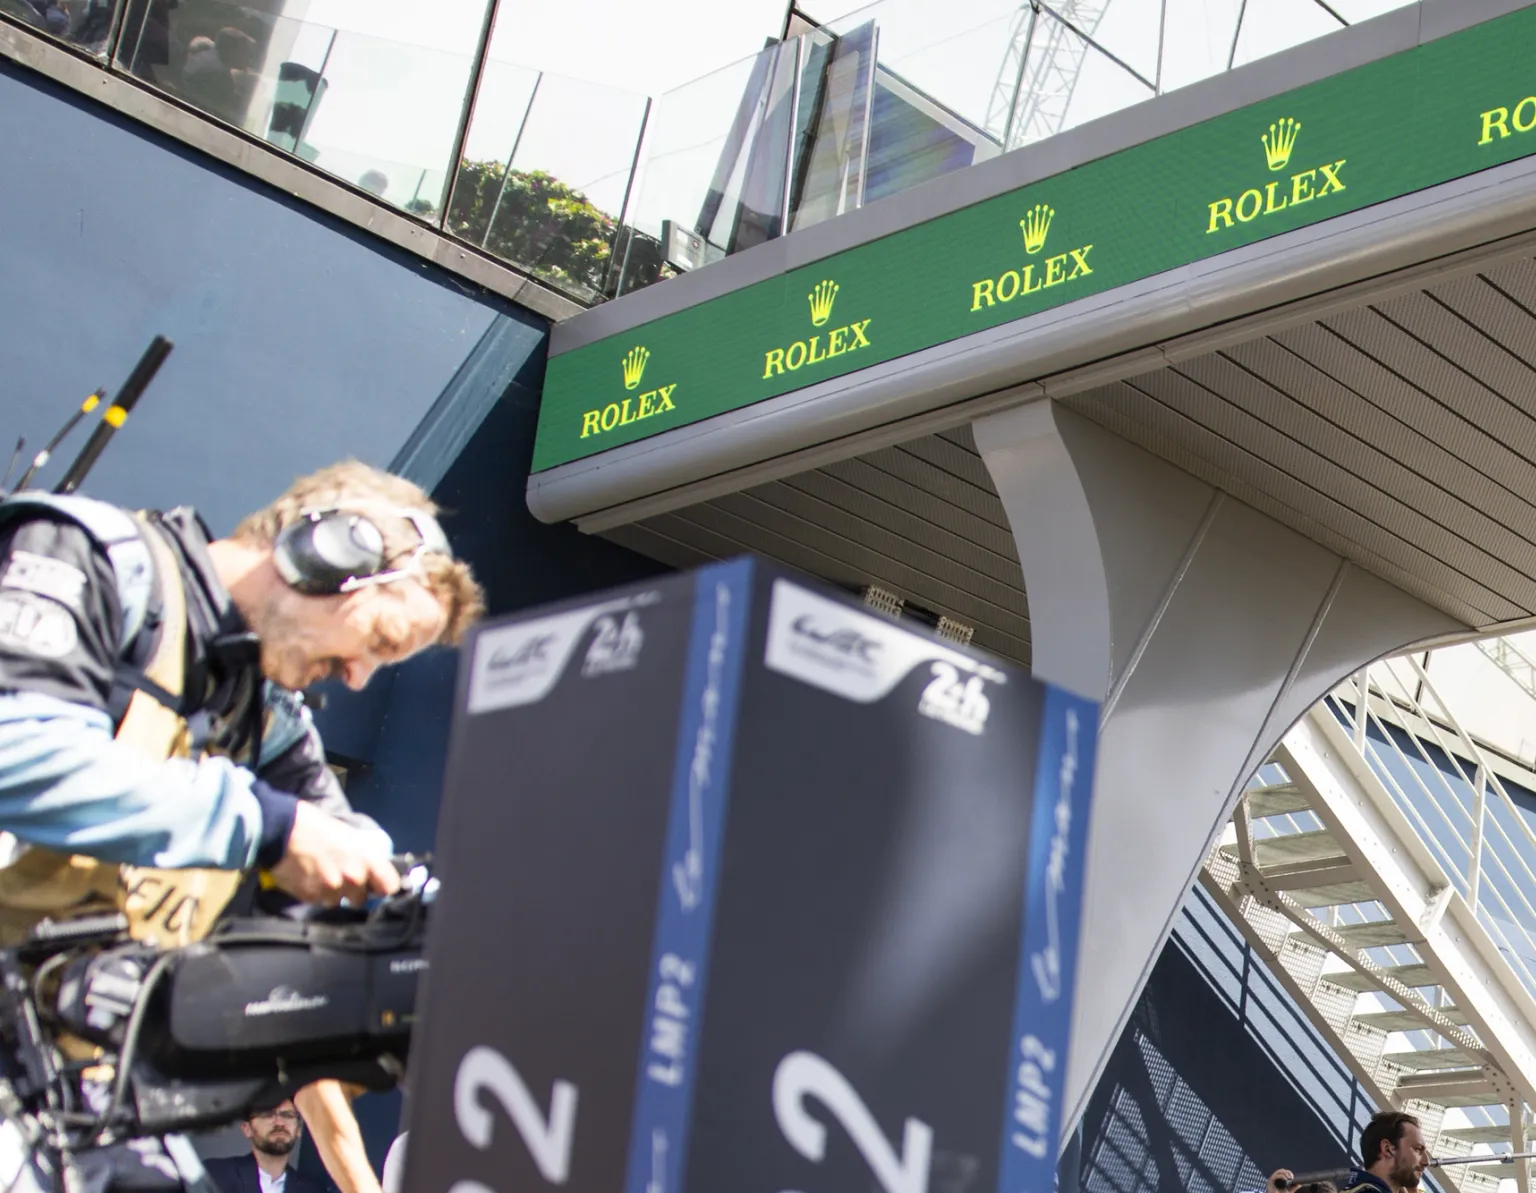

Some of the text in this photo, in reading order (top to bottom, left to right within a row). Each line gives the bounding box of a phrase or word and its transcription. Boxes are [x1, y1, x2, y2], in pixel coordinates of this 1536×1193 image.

[1205, 159, 1347, 234] ROLEX
[969, 244, 1094, 313] ROLEX
[762, 319, 872, 380] ROLEX
[580, 383, 678, 440] ROLEX
[647, 952, 696, 1089] LMP2
[1011, 1033, 1057, 1160] LMP2
